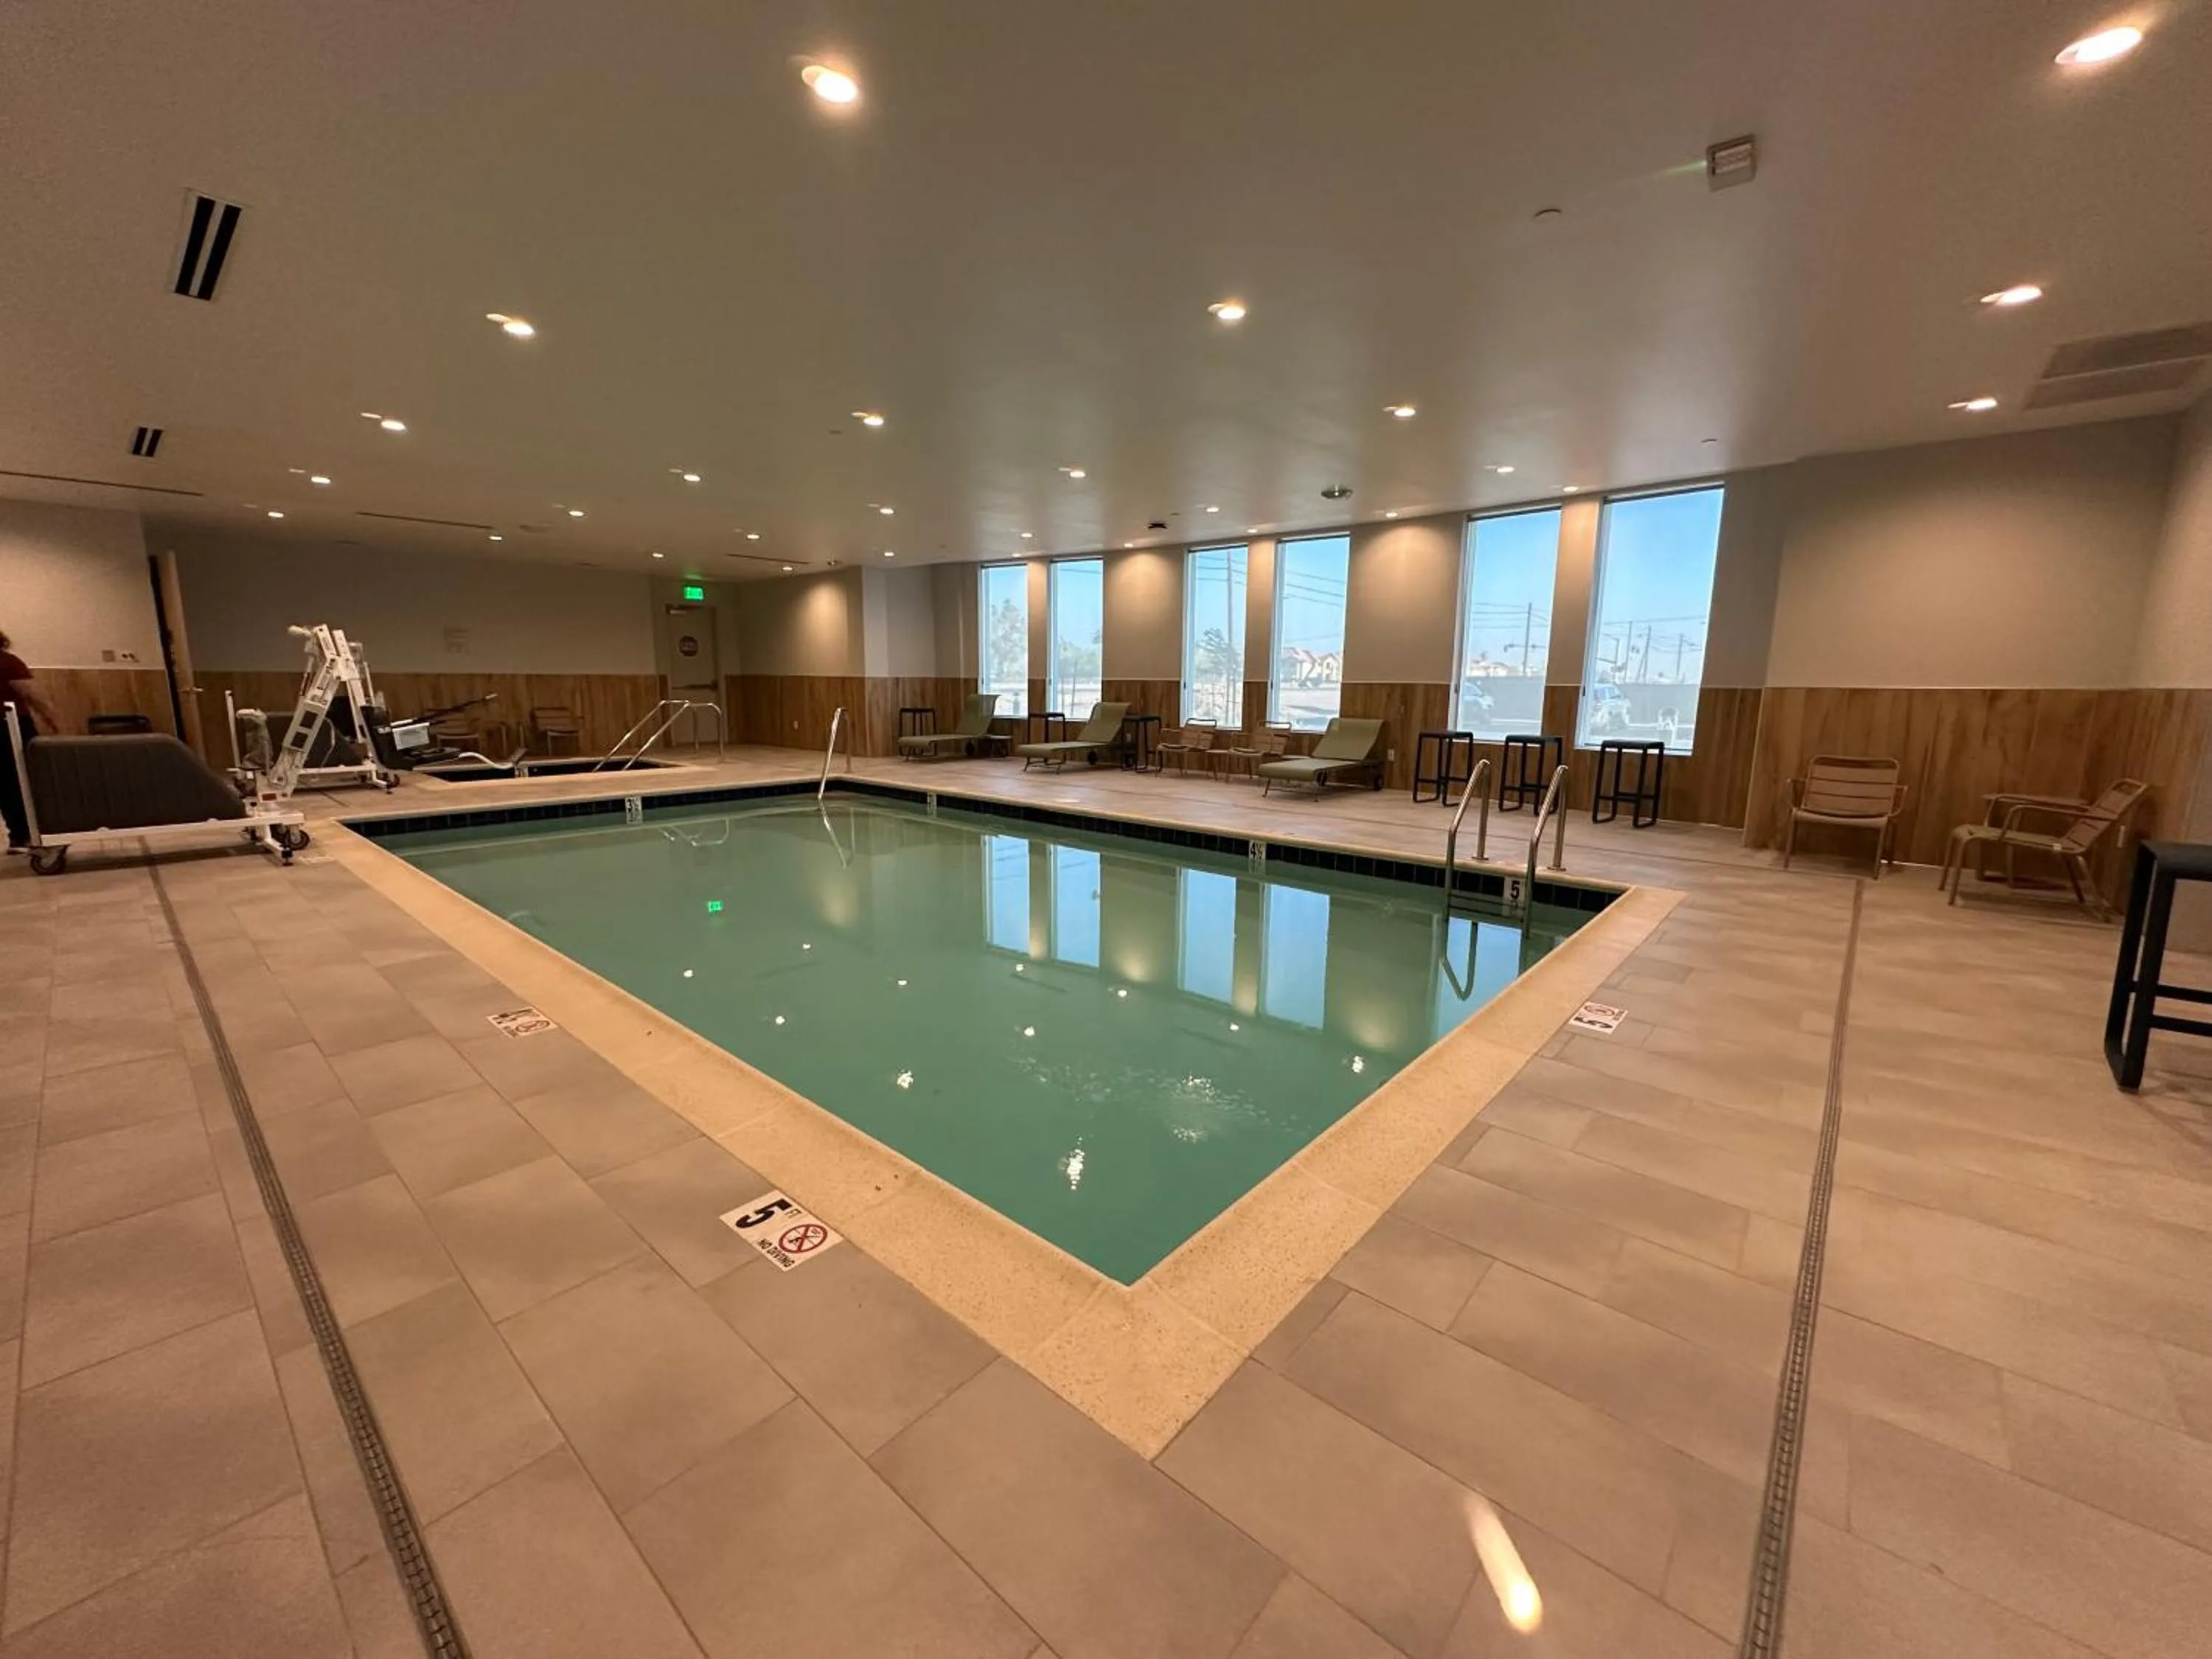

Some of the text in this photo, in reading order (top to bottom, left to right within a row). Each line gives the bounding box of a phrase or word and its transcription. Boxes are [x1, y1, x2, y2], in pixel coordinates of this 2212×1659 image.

[1510, 880, 1520, 900] 5
[735, 1198, 793, 1228] 5
[757, 1238, 796, 1267] NO DIVING
